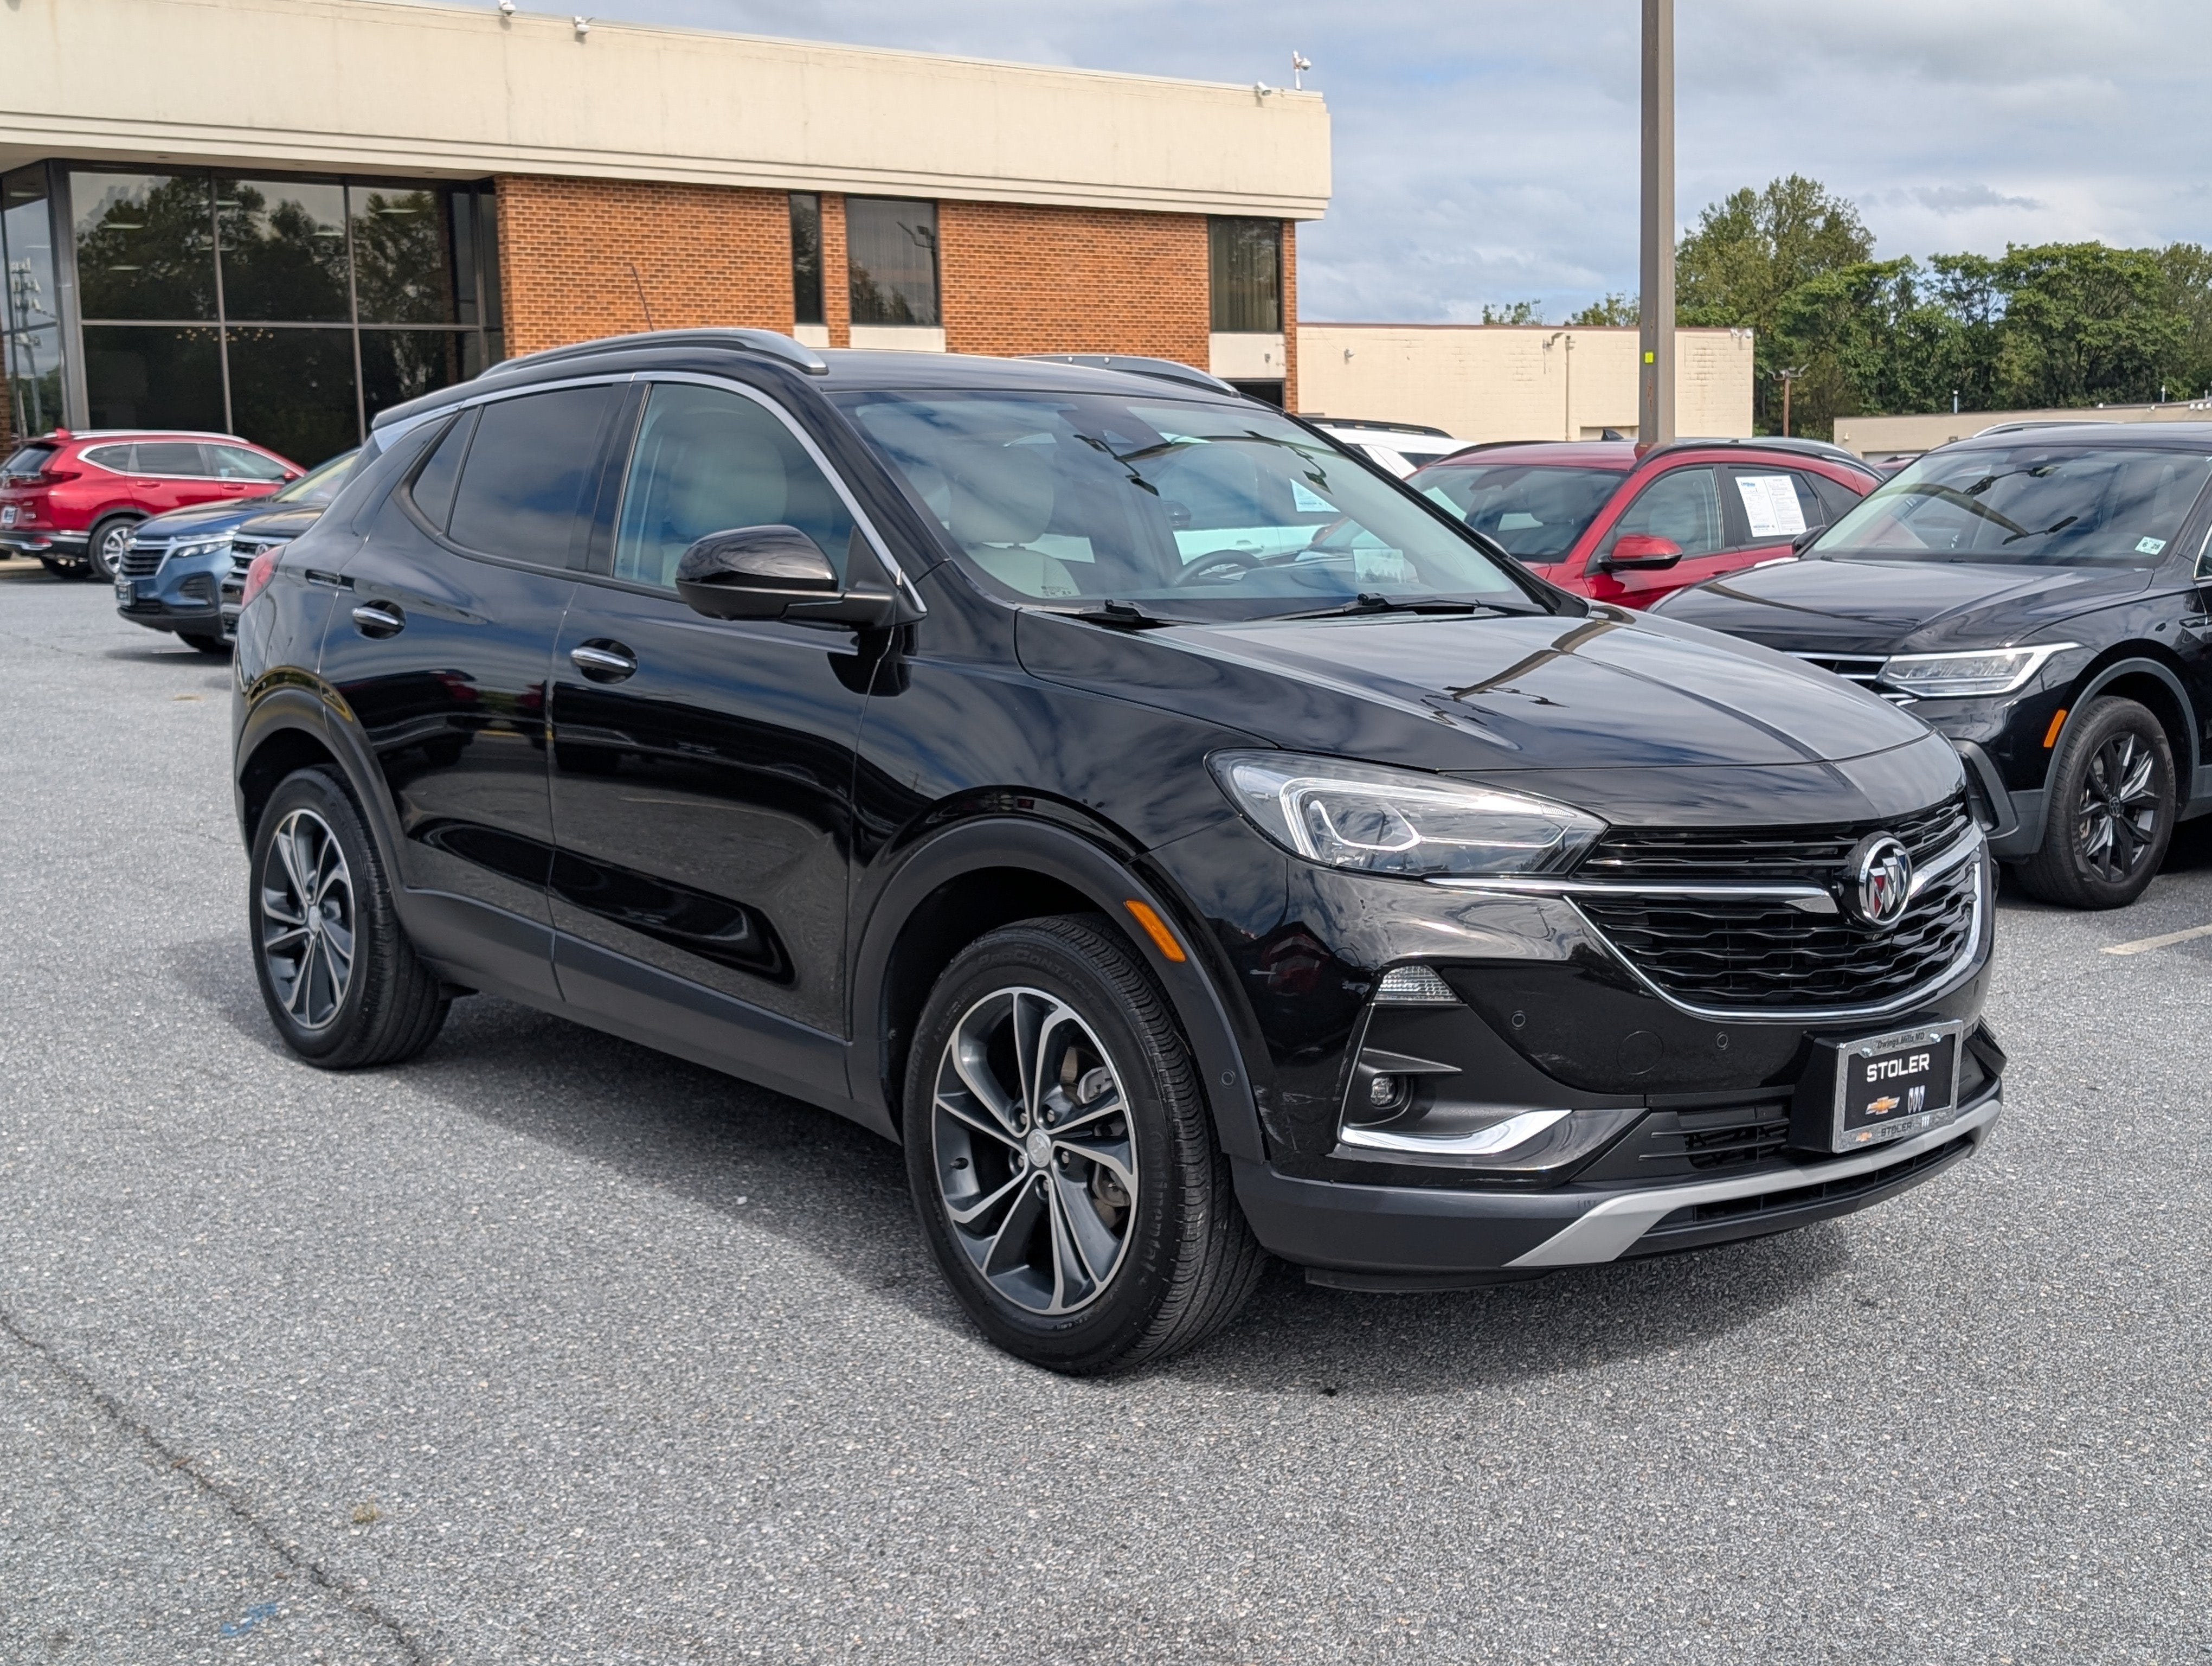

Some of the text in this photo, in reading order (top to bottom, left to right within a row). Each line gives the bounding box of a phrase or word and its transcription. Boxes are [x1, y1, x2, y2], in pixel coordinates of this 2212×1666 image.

[1915, 1031, 1925, 1041] MD
[1866, 1053, 1930, 1082] STOLER
[1881, 1121, 1913, 1137] STOLER
